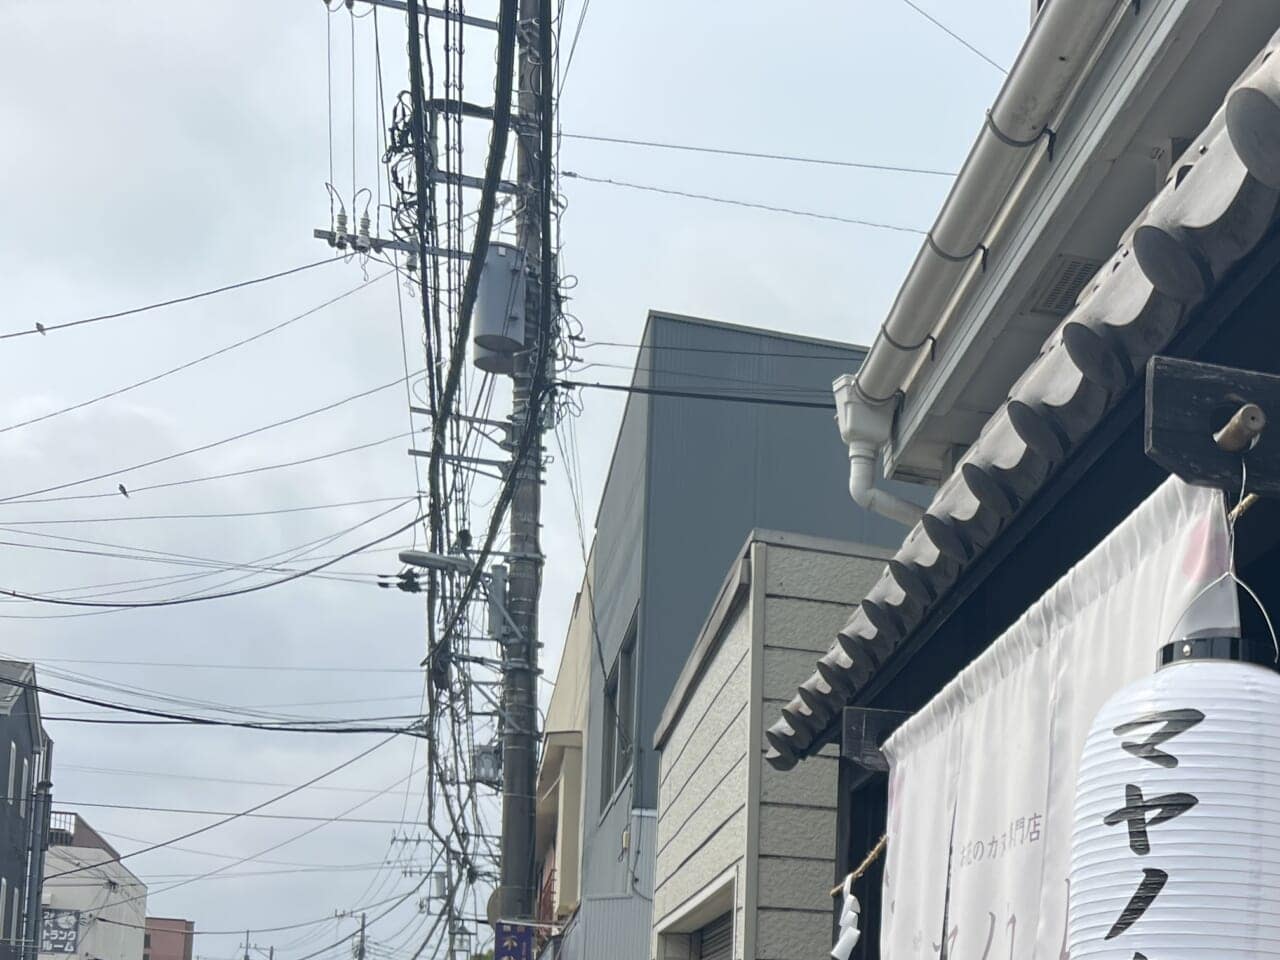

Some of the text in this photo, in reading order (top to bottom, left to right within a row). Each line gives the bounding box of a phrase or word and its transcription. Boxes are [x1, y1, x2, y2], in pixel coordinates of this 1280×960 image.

[43, 929, 76, 941] トランク
[43, 941, 75, 952] ルーム
